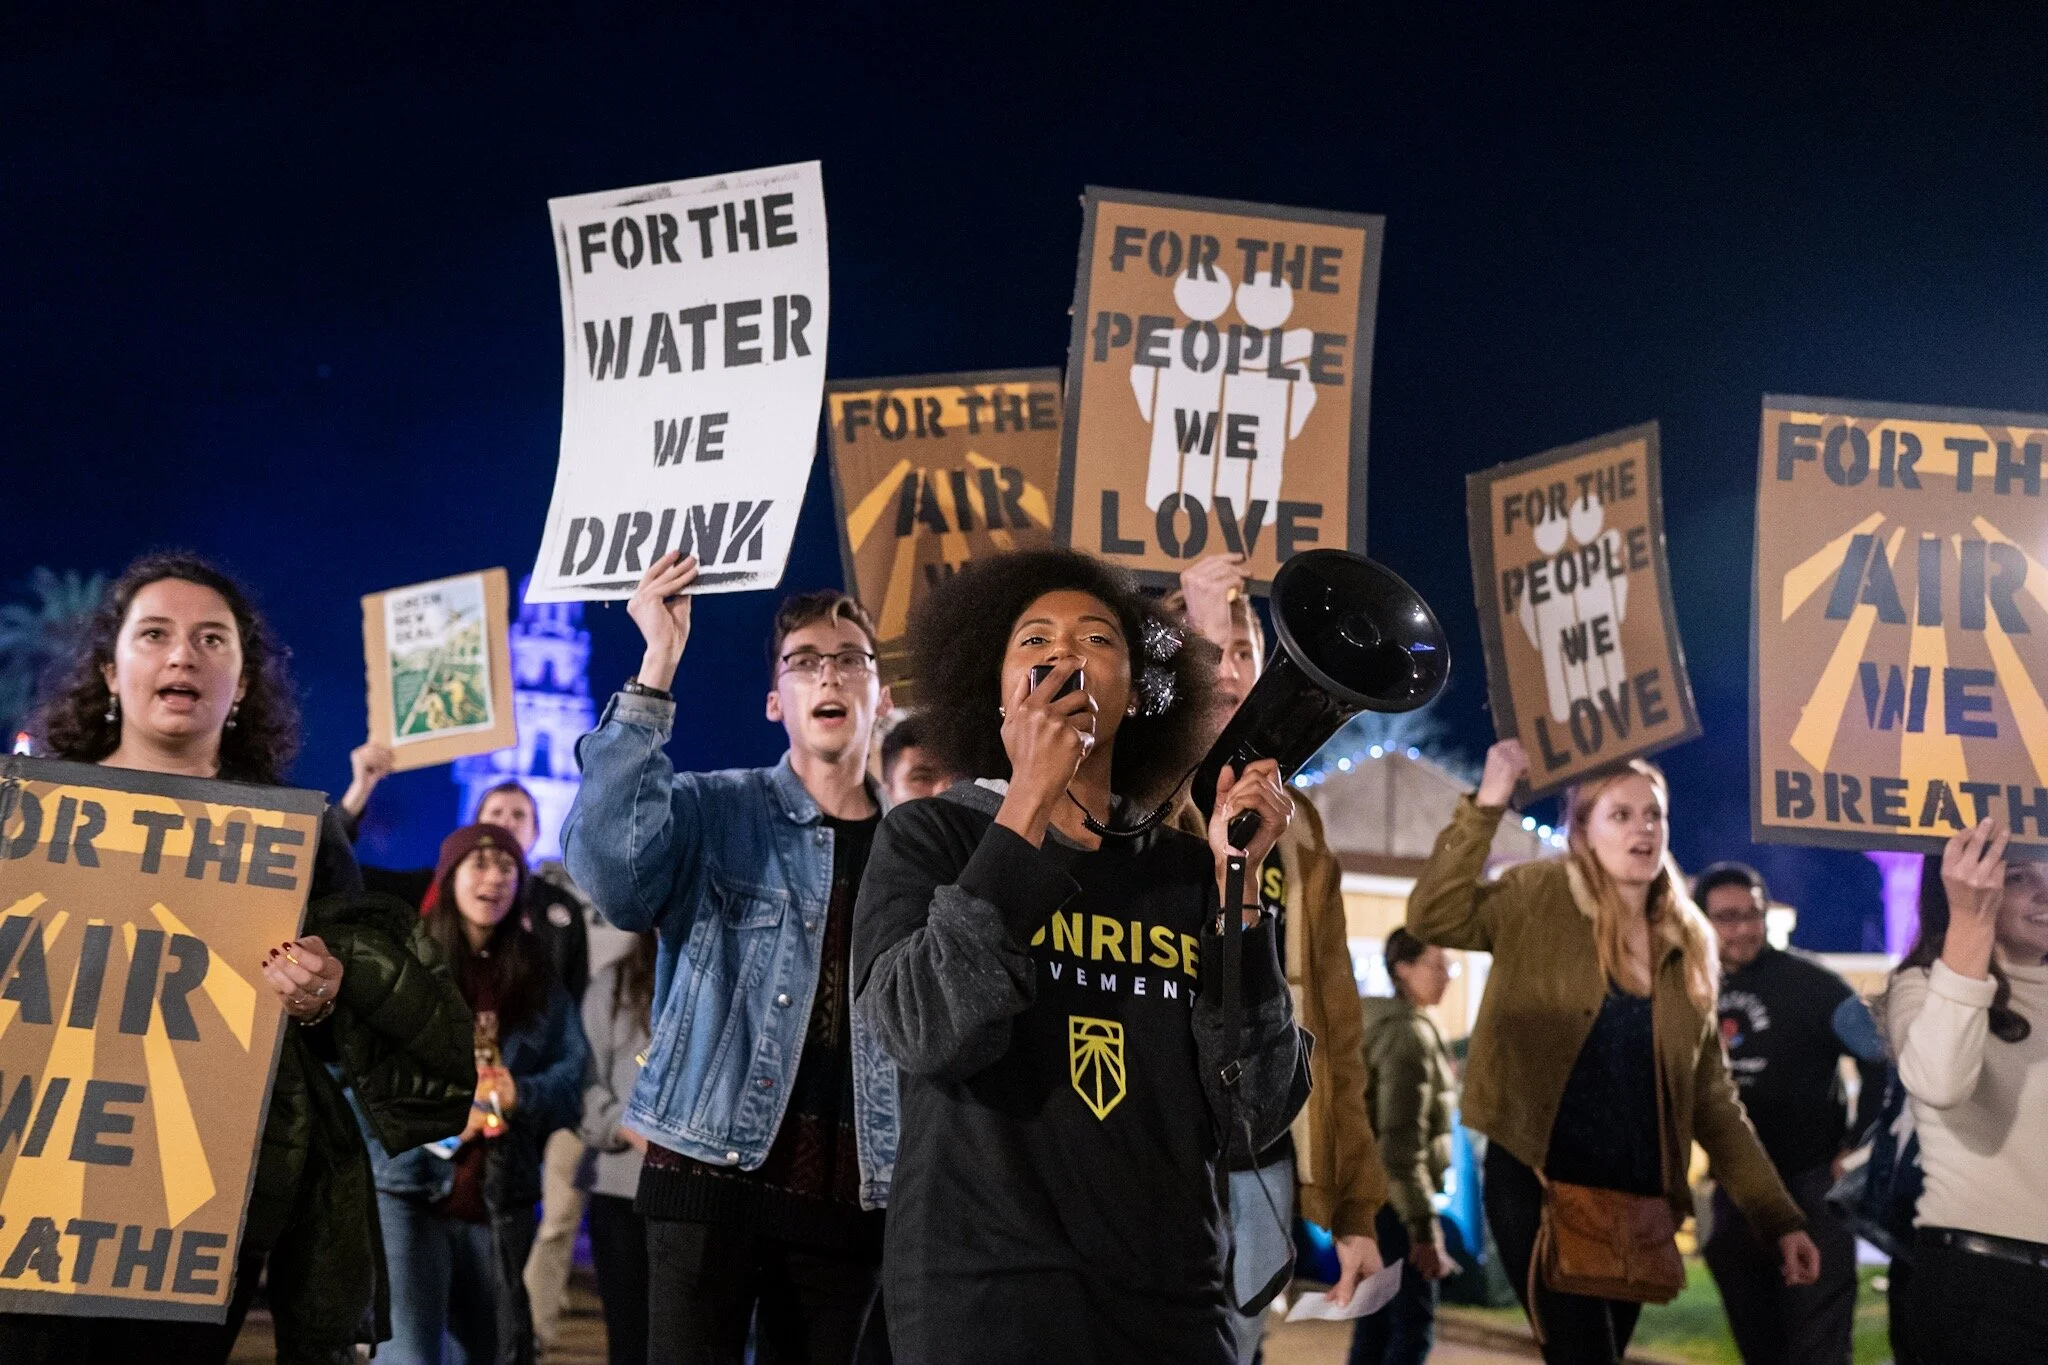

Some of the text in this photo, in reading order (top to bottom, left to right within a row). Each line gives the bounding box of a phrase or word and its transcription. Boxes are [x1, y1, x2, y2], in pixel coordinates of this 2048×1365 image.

[578, 192, 798, 274] FOR THE
[1110, 225, 1343, 295] FOR THE
[583, 294, 812, 381] WATER
[1093, 311, 1348, 387] PEOPLE
[653, 412, 729, 468] WE
[842, 391, 1057, 443] FOR THE
[1174, 408, 1259, 460] WE
[1776, 421, 1923, 490] FOR
[895, 466, 1031, 537] AIR
[1101, 489, 1324, 564] LOVE
[1503, 459, 1637, 536] FOR THE
[558, 500, 774, 578] DRINK
[1501, 525, 1650, 615] PEOPLE
[1824, 533, 2031, 635] AIR
[1560, 614, 1615, 667] WE
[1534, 668, 1669, 771] LOVE
[1859, 661, 1998, 739] WE
[132, 808, 306, 891] THE
[0, 915, 210, 1042] AIR
[0, 1070, 147, 1168] WE
[0, 1215, 229, 1297] ATHE
